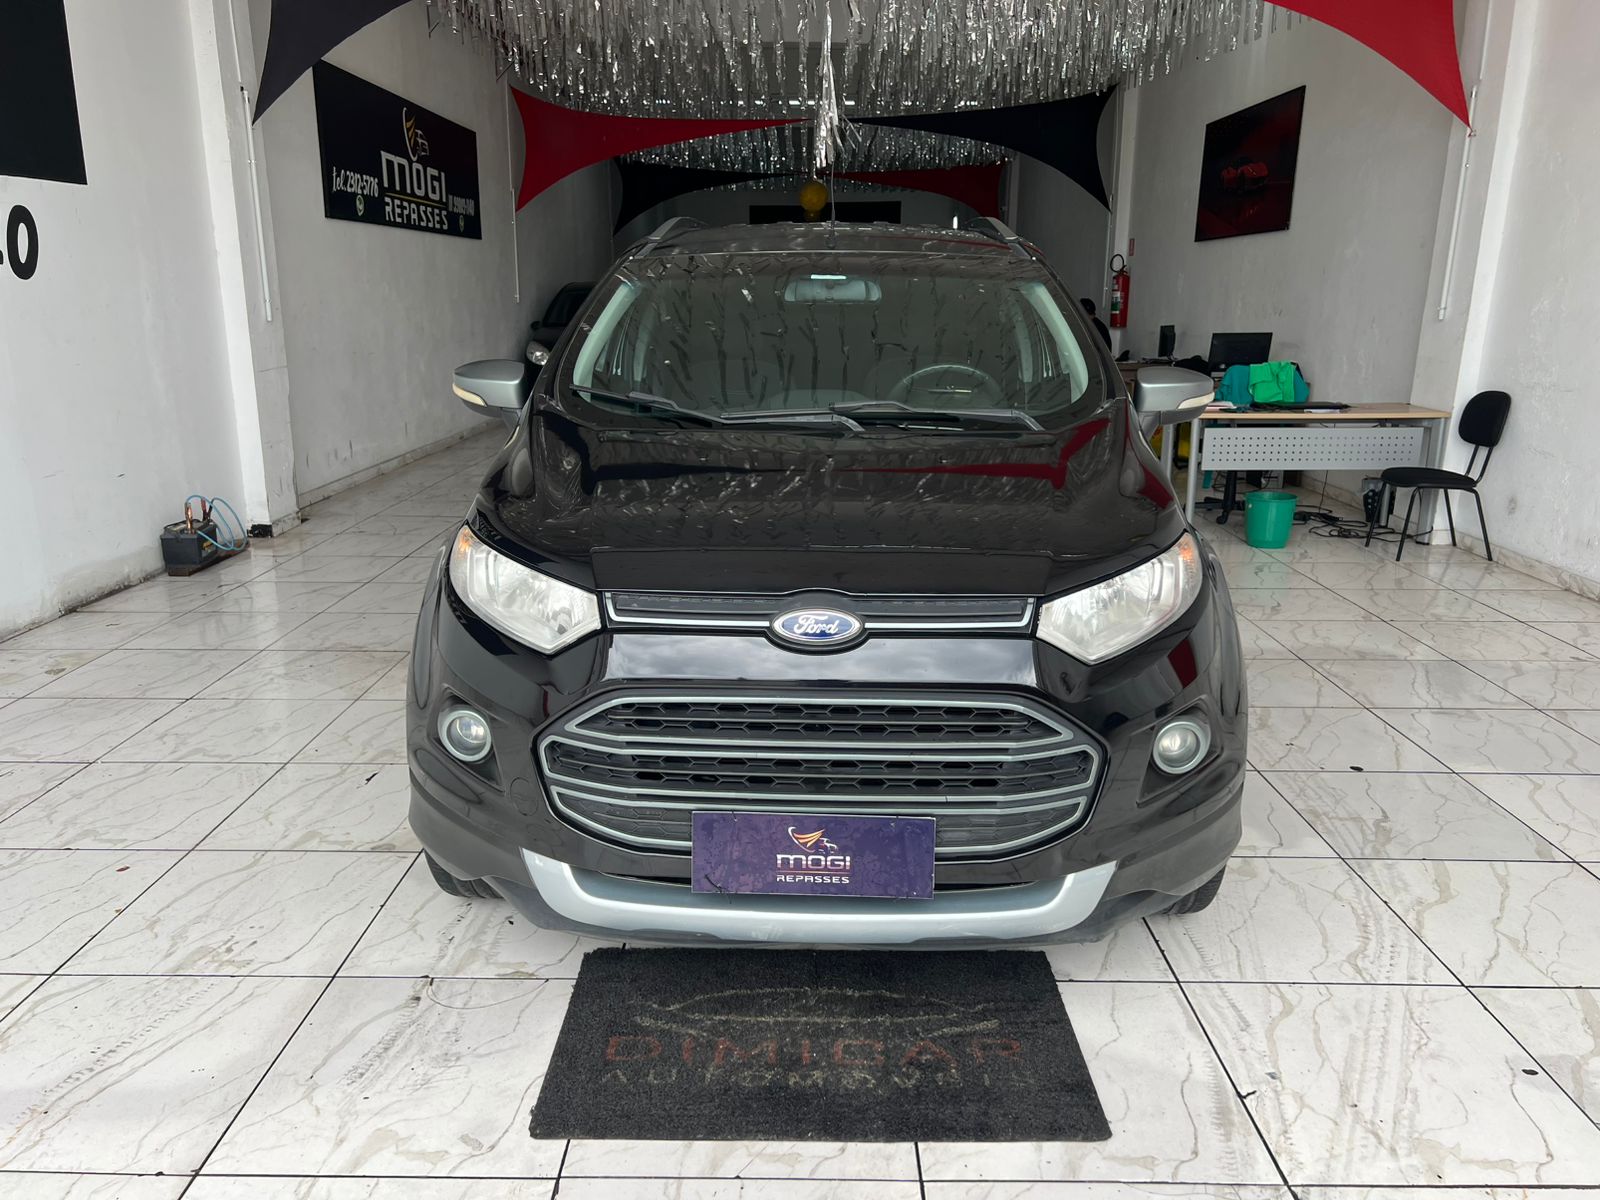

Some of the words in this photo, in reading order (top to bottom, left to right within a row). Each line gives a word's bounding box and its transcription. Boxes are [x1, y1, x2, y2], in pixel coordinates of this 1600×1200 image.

[381, 151, 447, 202] MOGI
[384, 196, 449, 230] REPASSES
[793, 614, 840, 634] Ford
[776, 854, 851, 870] MOGI
[776, 874, 850, 884] REPASSES
[606, 1034, 1023, 1067] DIMICAR
